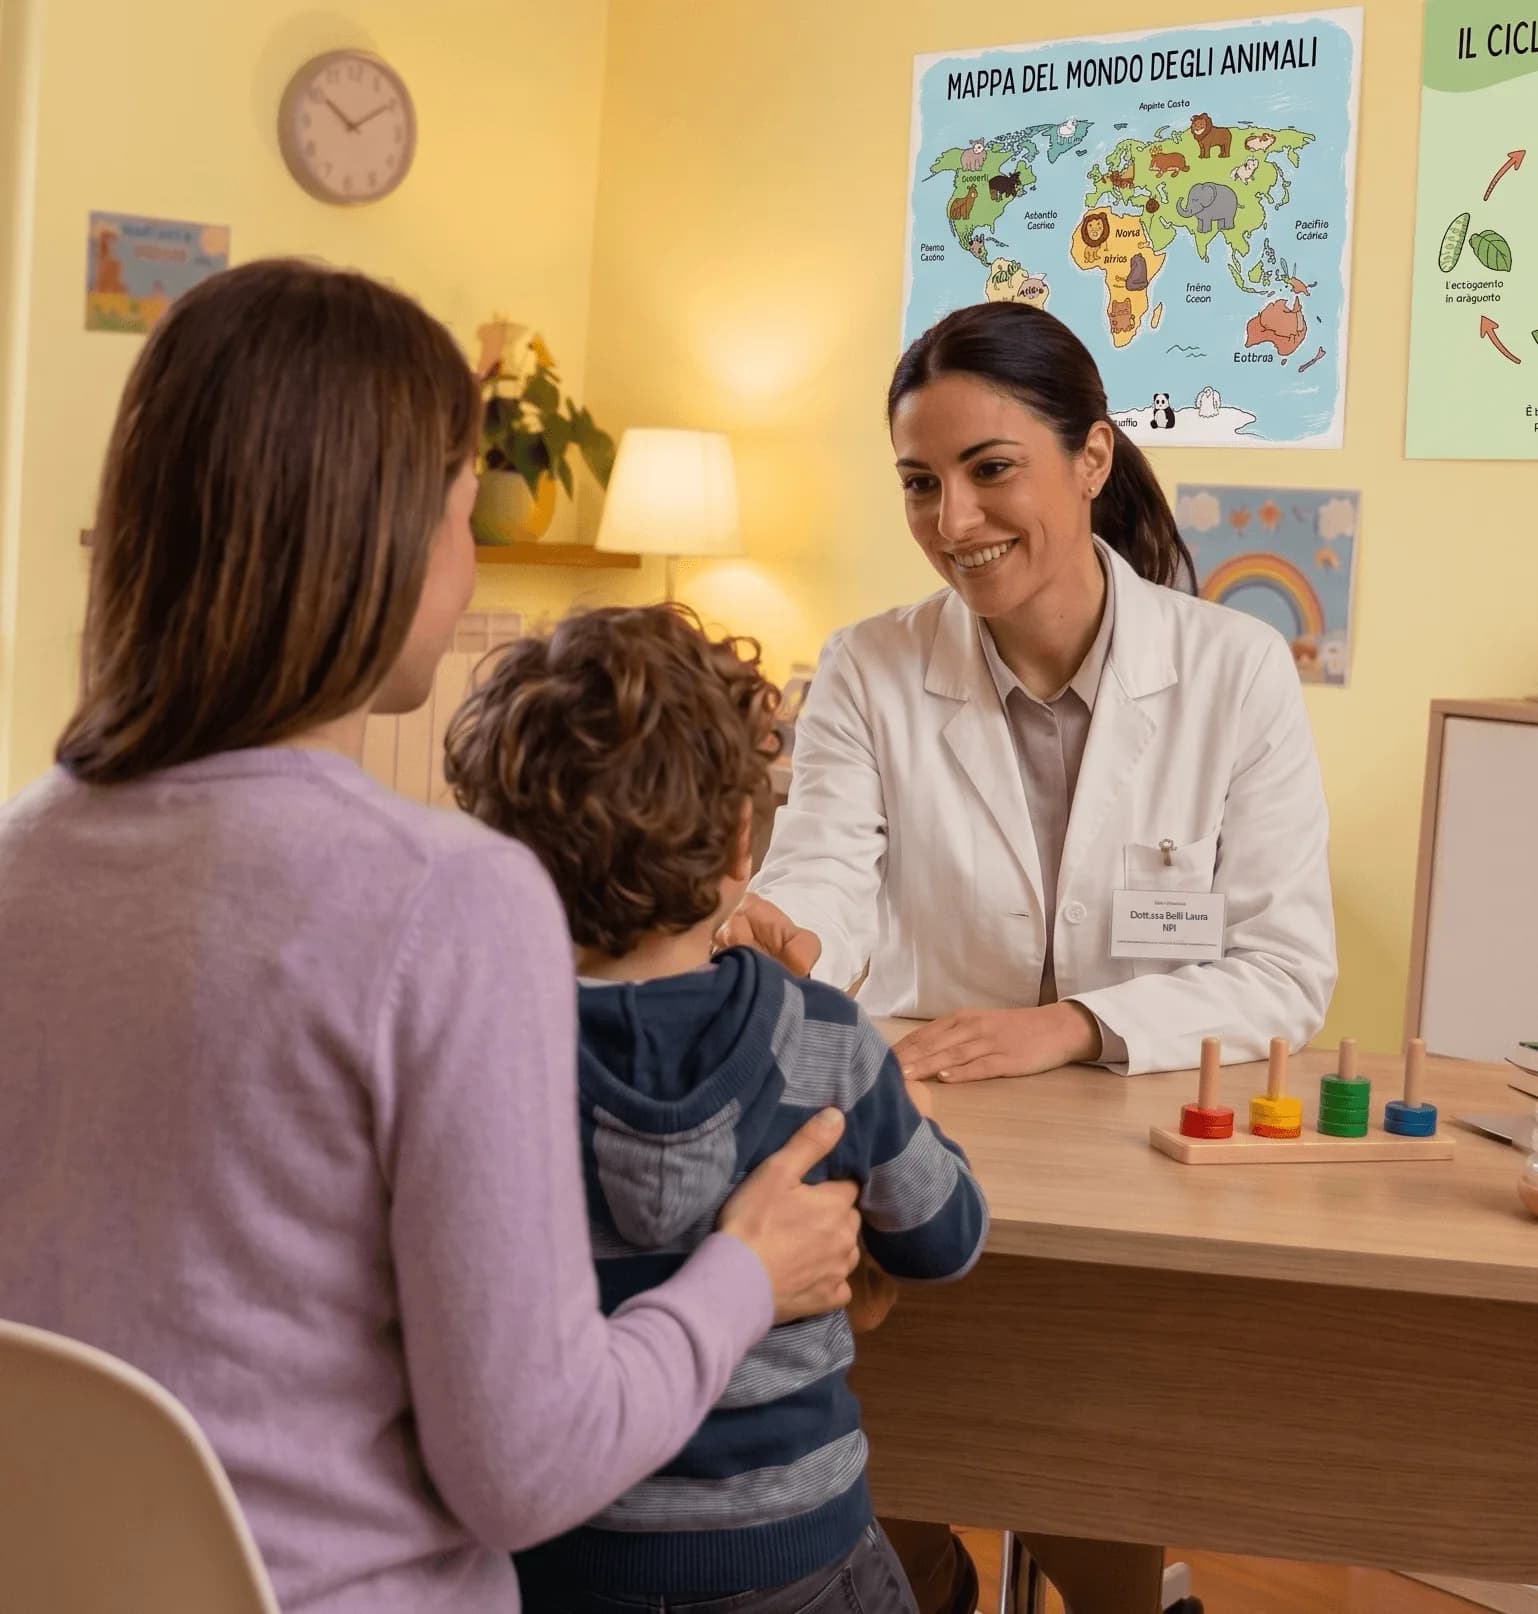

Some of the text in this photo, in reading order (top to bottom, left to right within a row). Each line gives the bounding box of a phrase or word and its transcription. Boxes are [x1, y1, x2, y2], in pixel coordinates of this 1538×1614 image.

[1458, 26, 1478, 60] IL
[947, 36, 1317, 101] MAPPA DEL MONDO DEGLI ANIMALI
[1445, 294, 1454, 304] in
[1130, 910, 1209, 921] Dott.ssa Belli Laura
[1162, 923, 1177, 932] NPI
